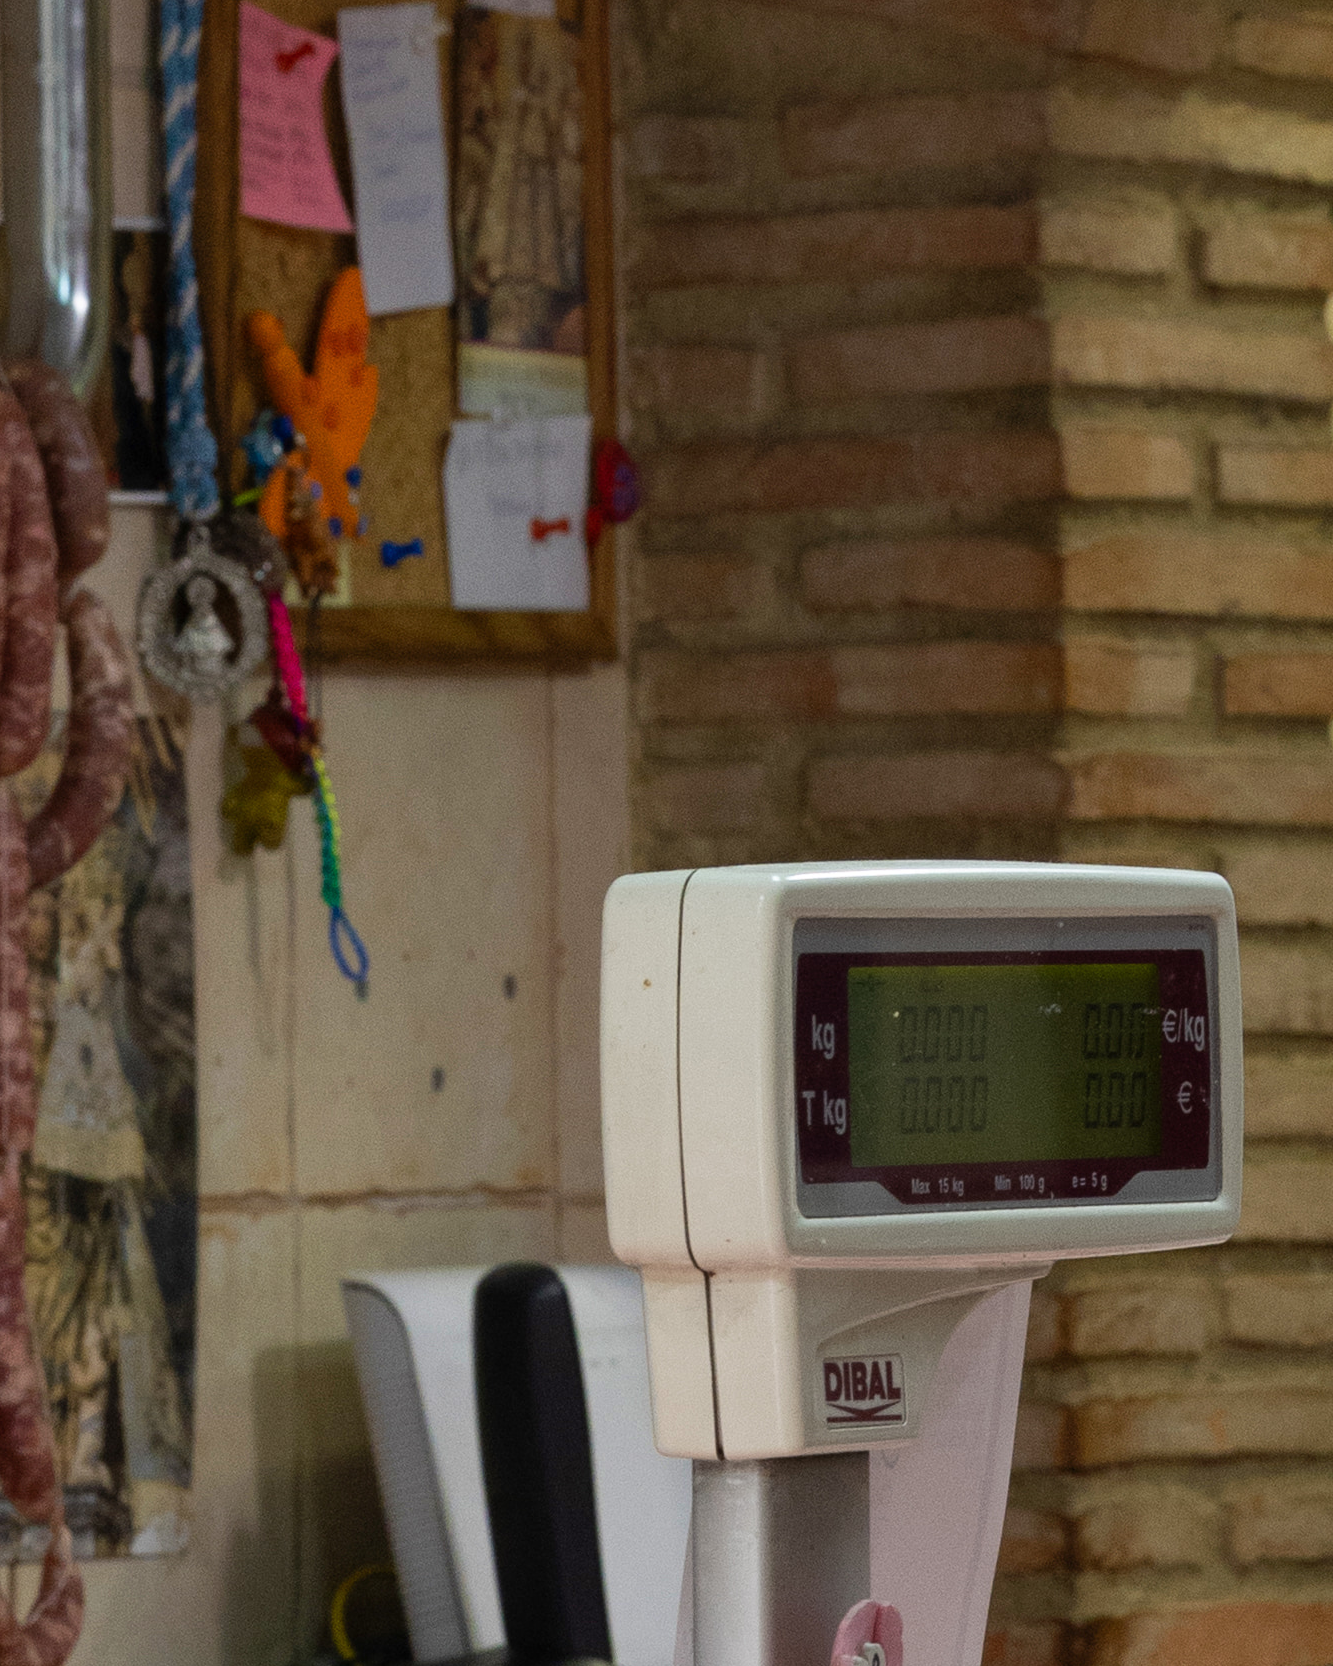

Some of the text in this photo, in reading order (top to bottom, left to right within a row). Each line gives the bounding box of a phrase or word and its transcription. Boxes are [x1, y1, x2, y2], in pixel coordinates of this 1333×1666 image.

[811, 1019, 835, 1061] kg
[1162, 1009, 1206, 1052] €/kg
[803, 1091, 847, 1134] T kg
[1177, 1081, 1193, 1114] €
[911, 1177, 964, 1197] Max 15 kg
[994, 1175, 1012, 1191] Min
[1019, 1174, 1035, 1190] 100
[823, 1359, 901, 1402] DIBAL
